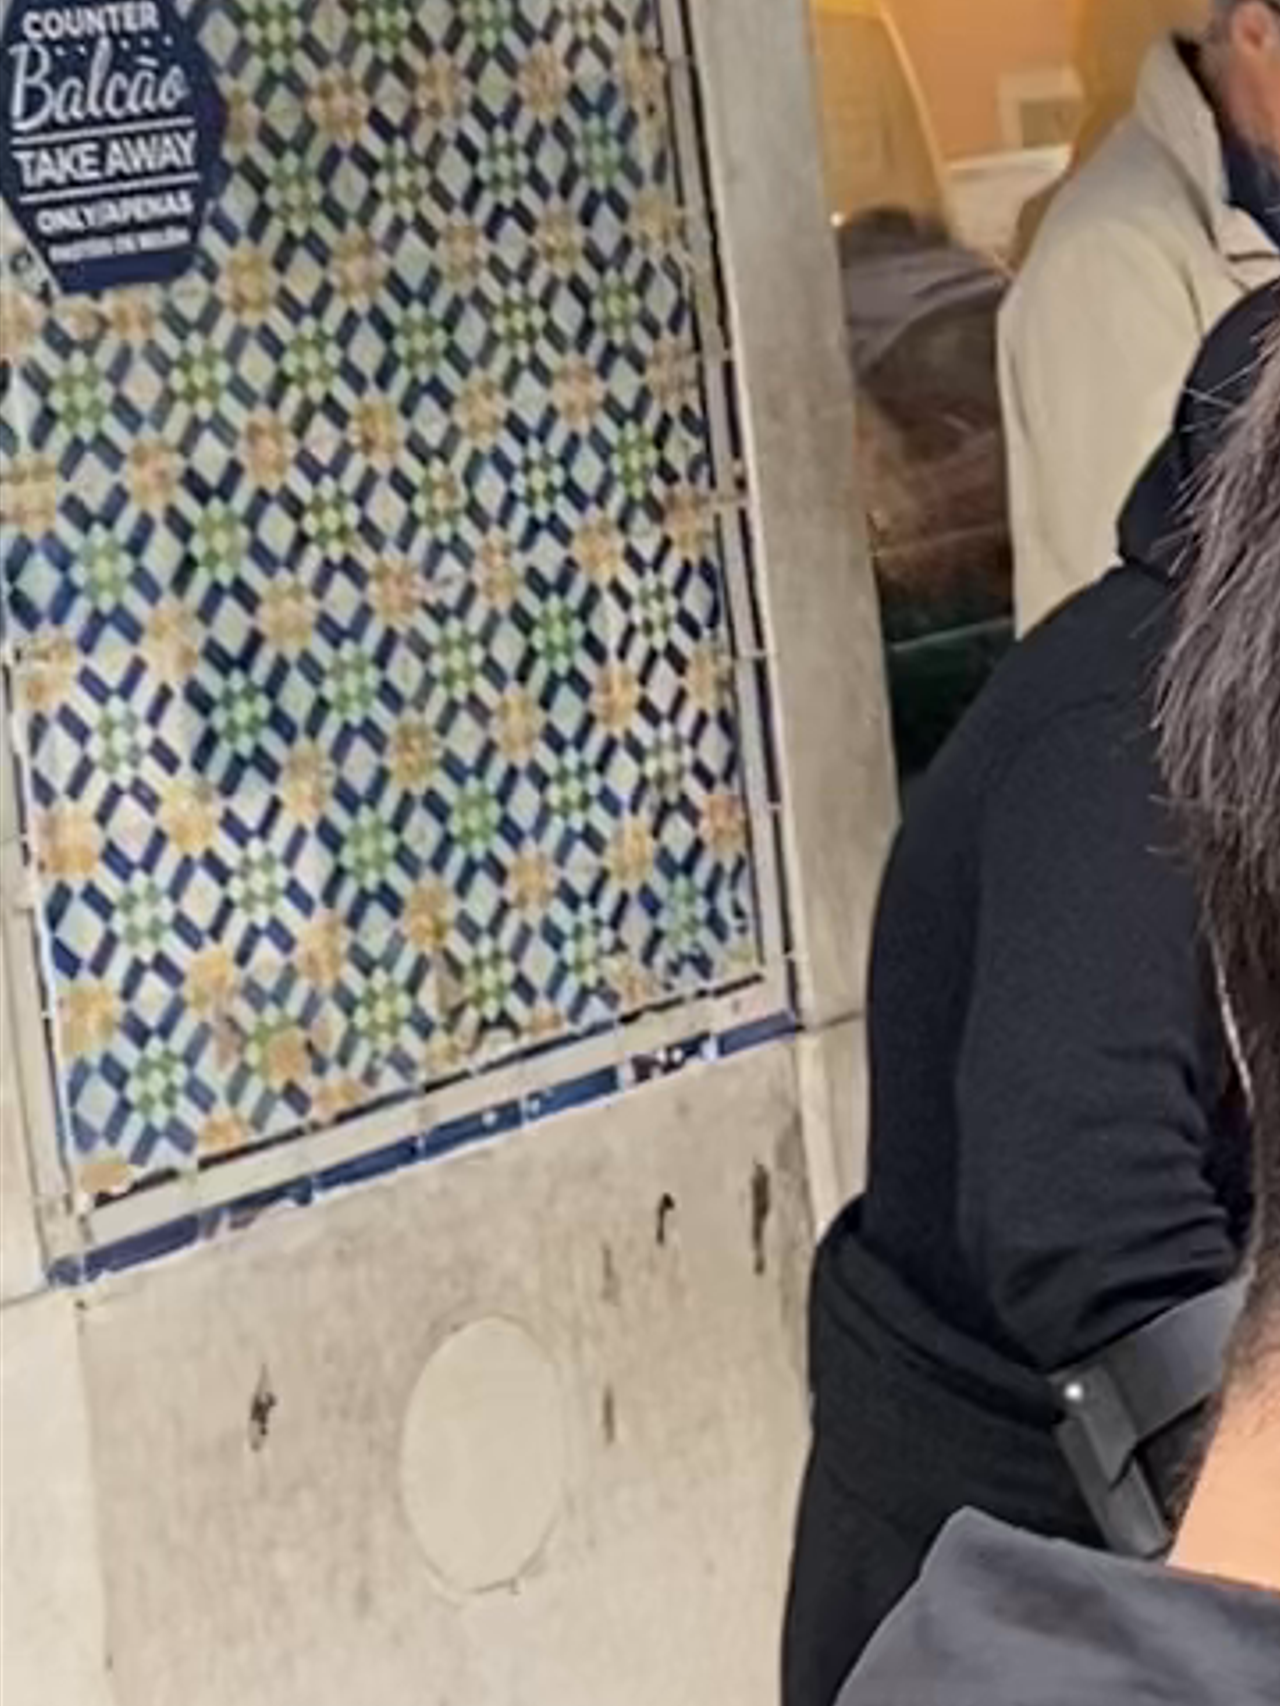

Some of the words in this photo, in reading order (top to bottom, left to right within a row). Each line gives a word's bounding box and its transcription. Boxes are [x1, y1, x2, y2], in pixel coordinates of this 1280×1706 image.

[23, 0, 159, 38] COUNTER
[9, 36, 189, 131] Balcão
[12, 141, 101, 188] TAKE
[105, 131, 197, 177] AWAY
